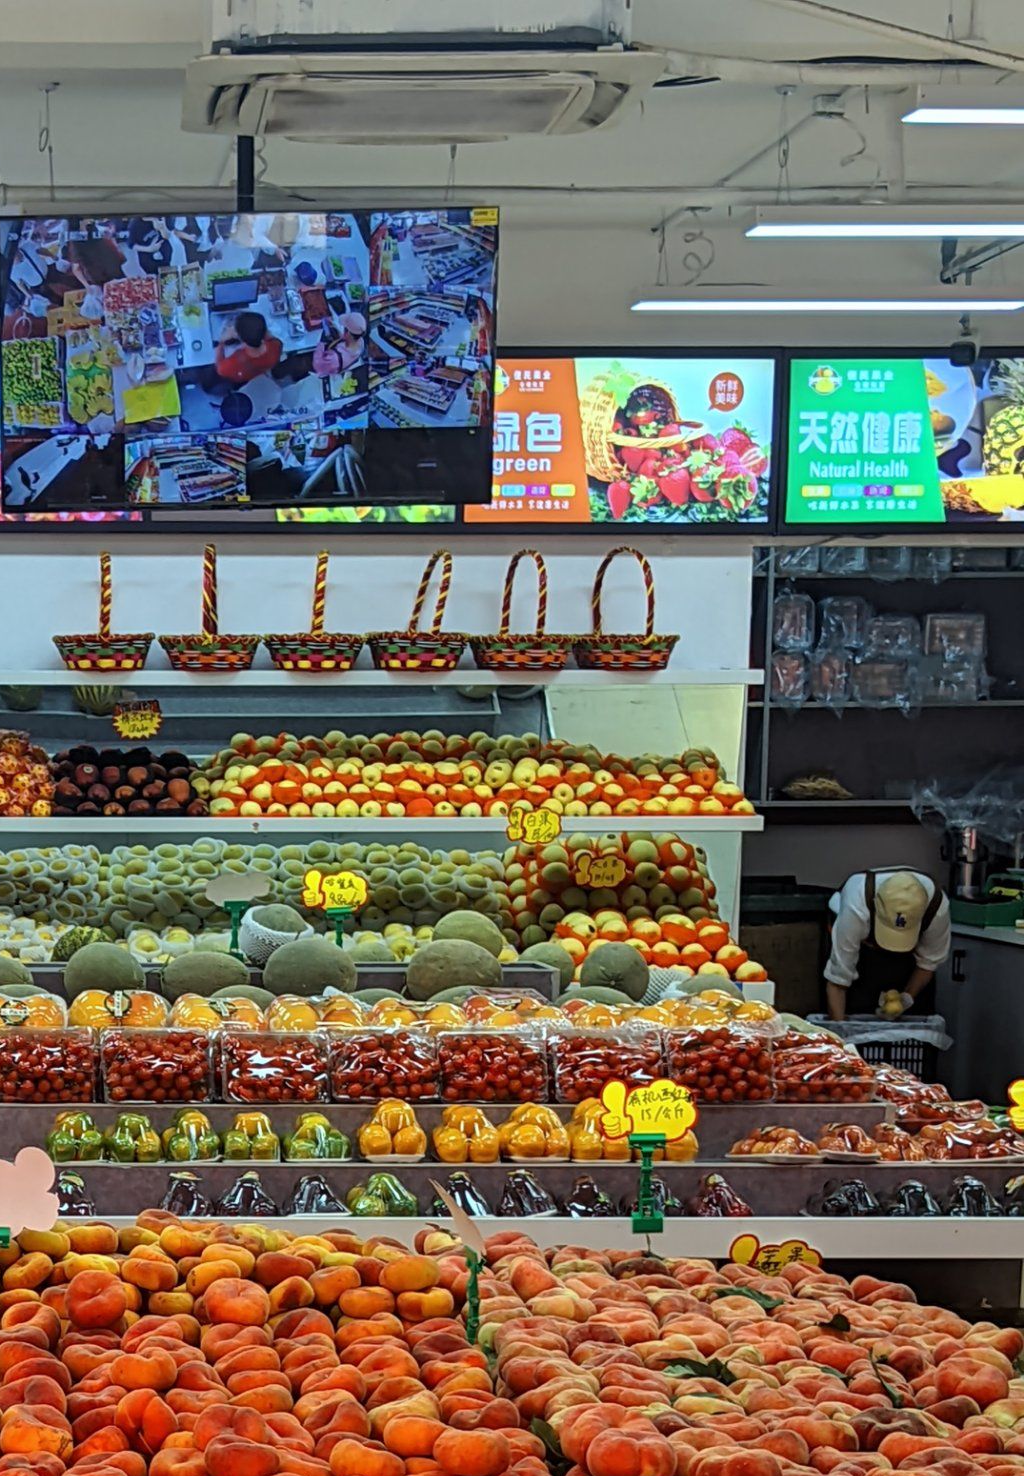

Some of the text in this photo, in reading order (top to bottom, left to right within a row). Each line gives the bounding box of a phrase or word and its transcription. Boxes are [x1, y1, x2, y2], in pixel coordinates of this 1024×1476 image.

[798, 411, 922, 454] 天然健康
[493, 457, 551, 476] green
[809, 459, 909, 478] Natural Health
